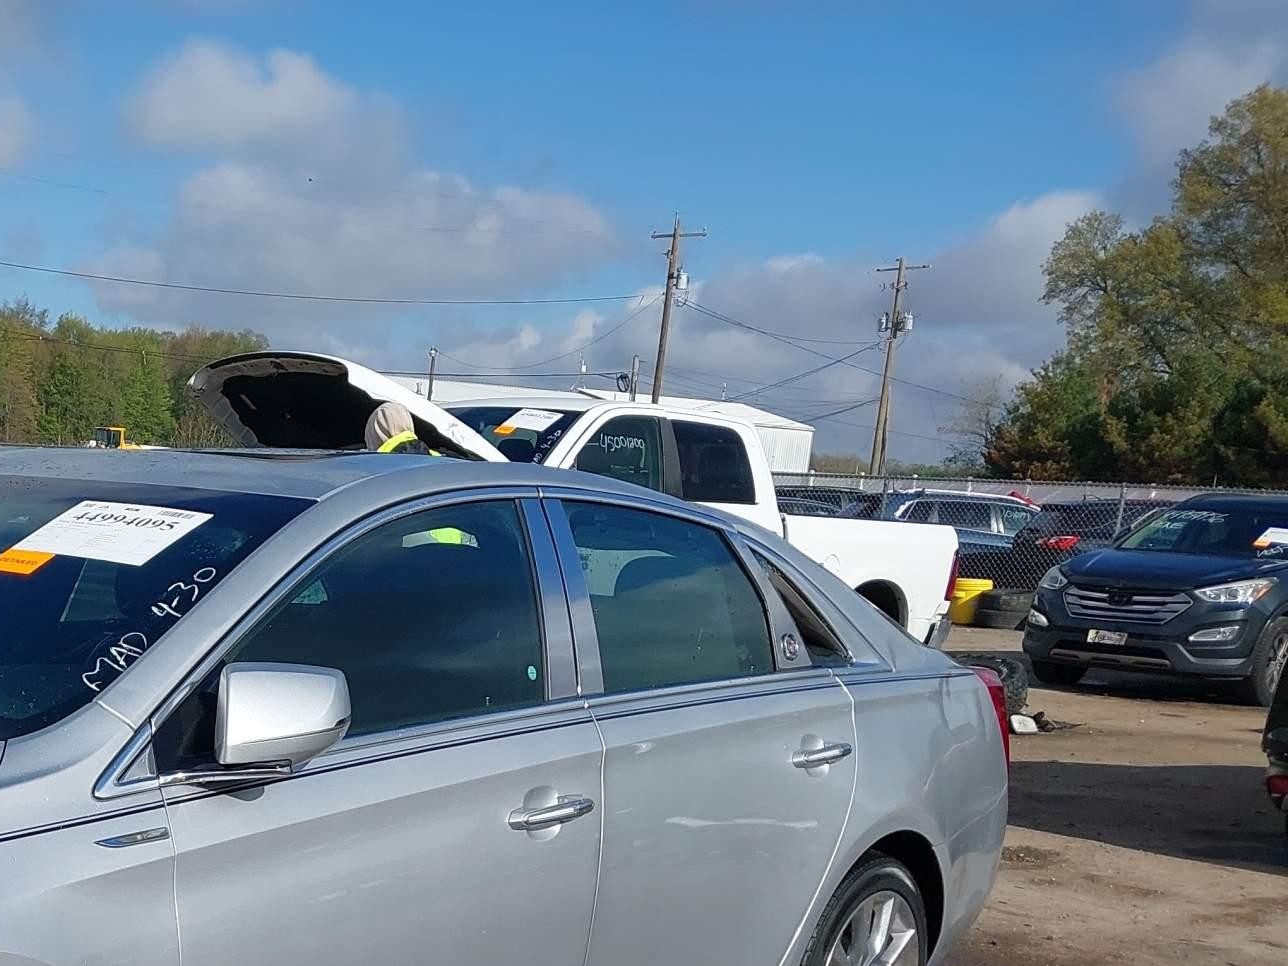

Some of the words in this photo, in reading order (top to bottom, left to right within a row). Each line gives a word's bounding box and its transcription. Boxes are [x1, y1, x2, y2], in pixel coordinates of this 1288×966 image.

[73, 511, 180, 531] 44994095
[81, 632, 148, 692] MAD
[151, 567, 217, 618] 4-30
